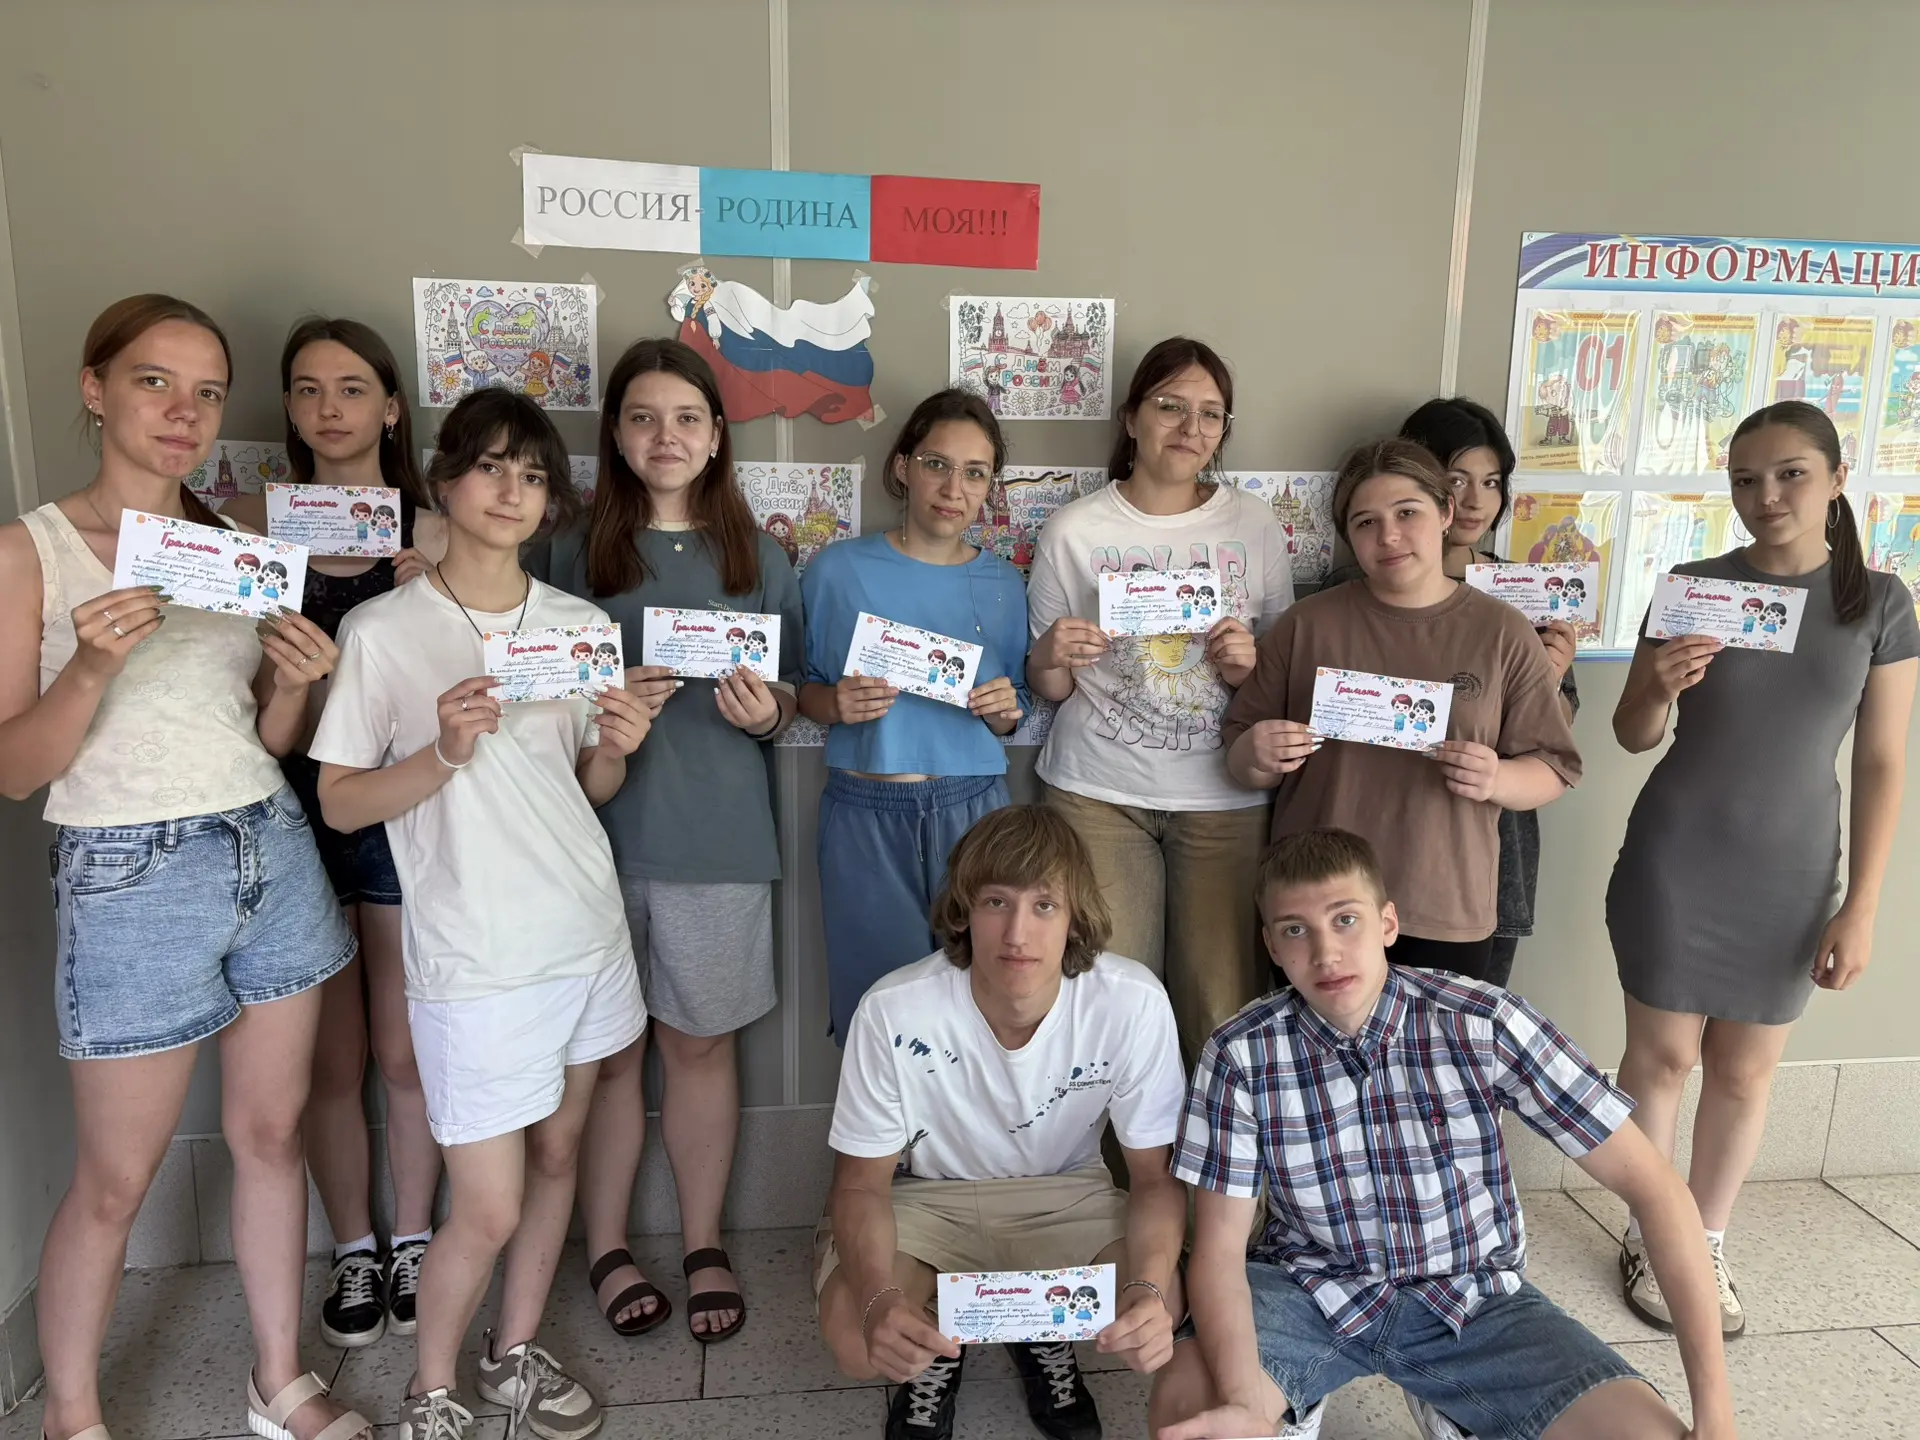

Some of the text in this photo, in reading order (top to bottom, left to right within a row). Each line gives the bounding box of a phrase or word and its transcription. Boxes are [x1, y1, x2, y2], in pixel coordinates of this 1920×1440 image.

[717, 196, 859, 229] РОДИНА
[903, 206, 1008, 237] МОЯ!!!
[1584, 243, 1920, 294] ИНФОРМАЦИ
[478, 320, 530, 336] С Днём
[480, 334, 536, 349] России!
[995, 354, 1060, 373] С Днём
[1576, 335, 1624, 391] 01
[1002, 370, 1064, 387] России!
[750, 476, 808, 495] С Днём
[289, 495, 338, 509] Грамота
[752, 495, 808, 512] России!
[1009, 489, 1021, 506] С
[161, 532, 222, 555] Грамота
[1493, 573, 1535, 585] Грамота
[1126, 582, 1167, 596] Грамота
[1684, 587, 1732, 601] Грамота
[672, 620, 716, 633] Грамота
[880, 630, 921, 650] Грамота
[507, 641, 558, 657] Грамота
[1335, 681, 1381, 697] Грамота
[975, 1283, 1032, 1298] Грамота
